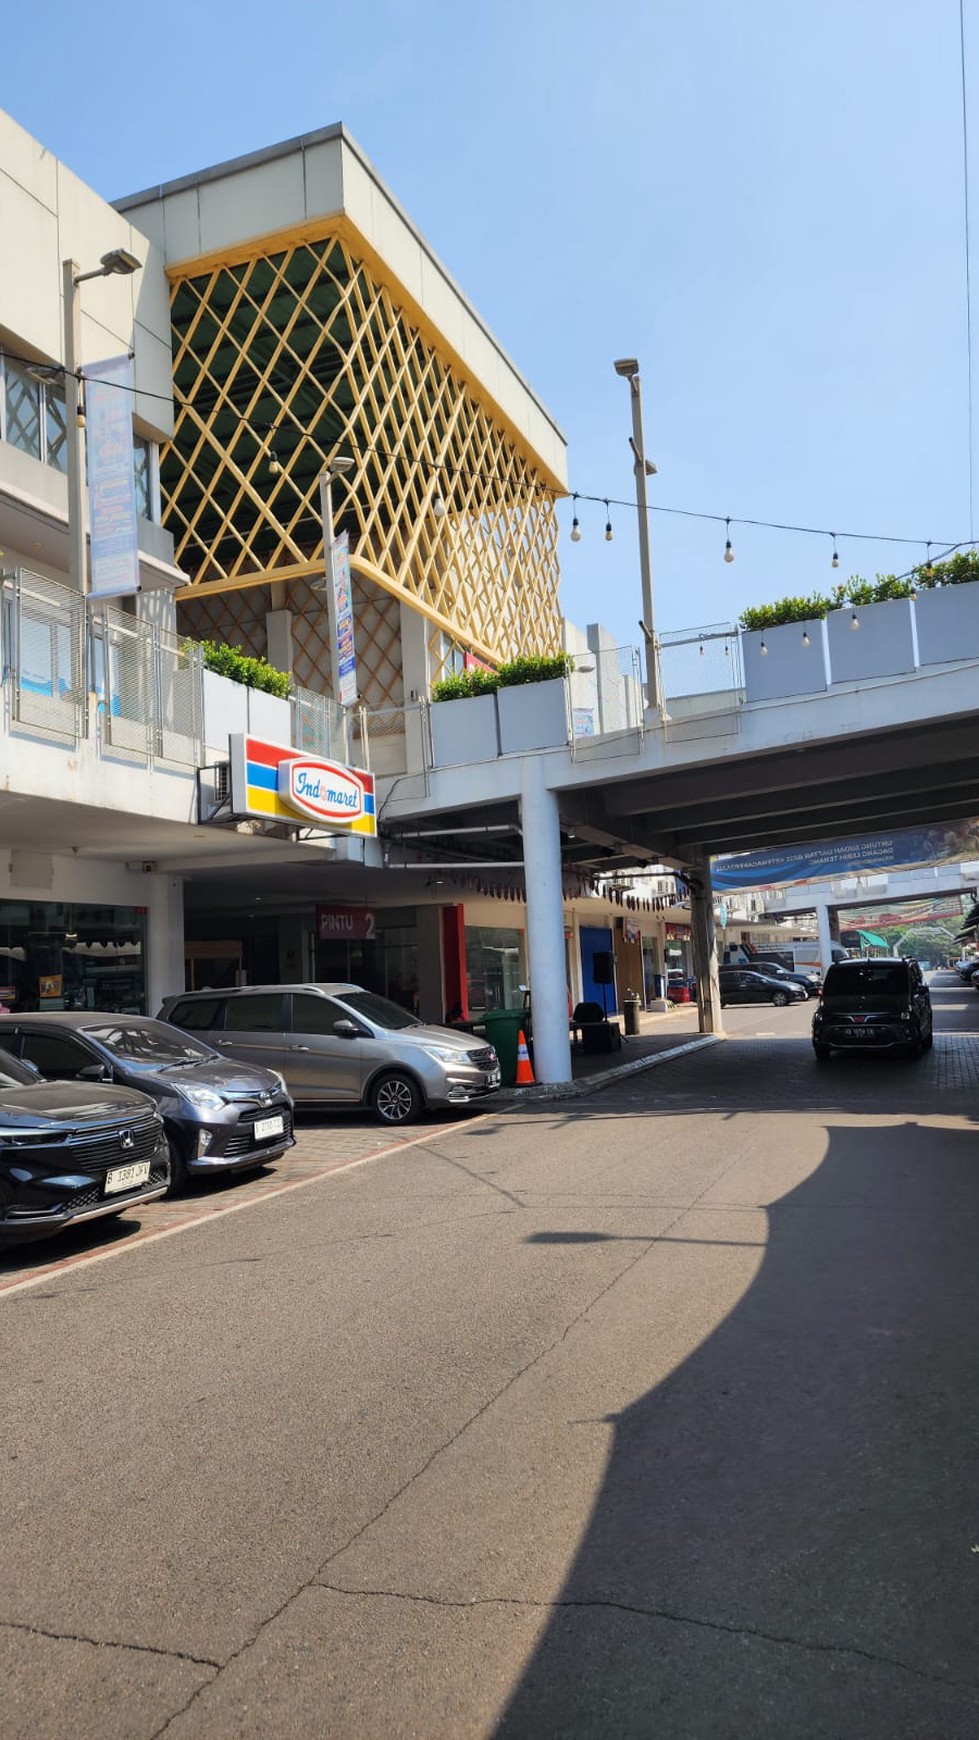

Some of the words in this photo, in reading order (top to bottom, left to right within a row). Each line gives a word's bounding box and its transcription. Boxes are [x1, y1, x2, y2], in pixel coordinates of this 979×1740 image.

[295, 772, 358, 808] Indomaret
[320, 912, 354, 930] PINTU
[364, 912, 376, 940] 2
[107, 1171, 113, 1184] B
